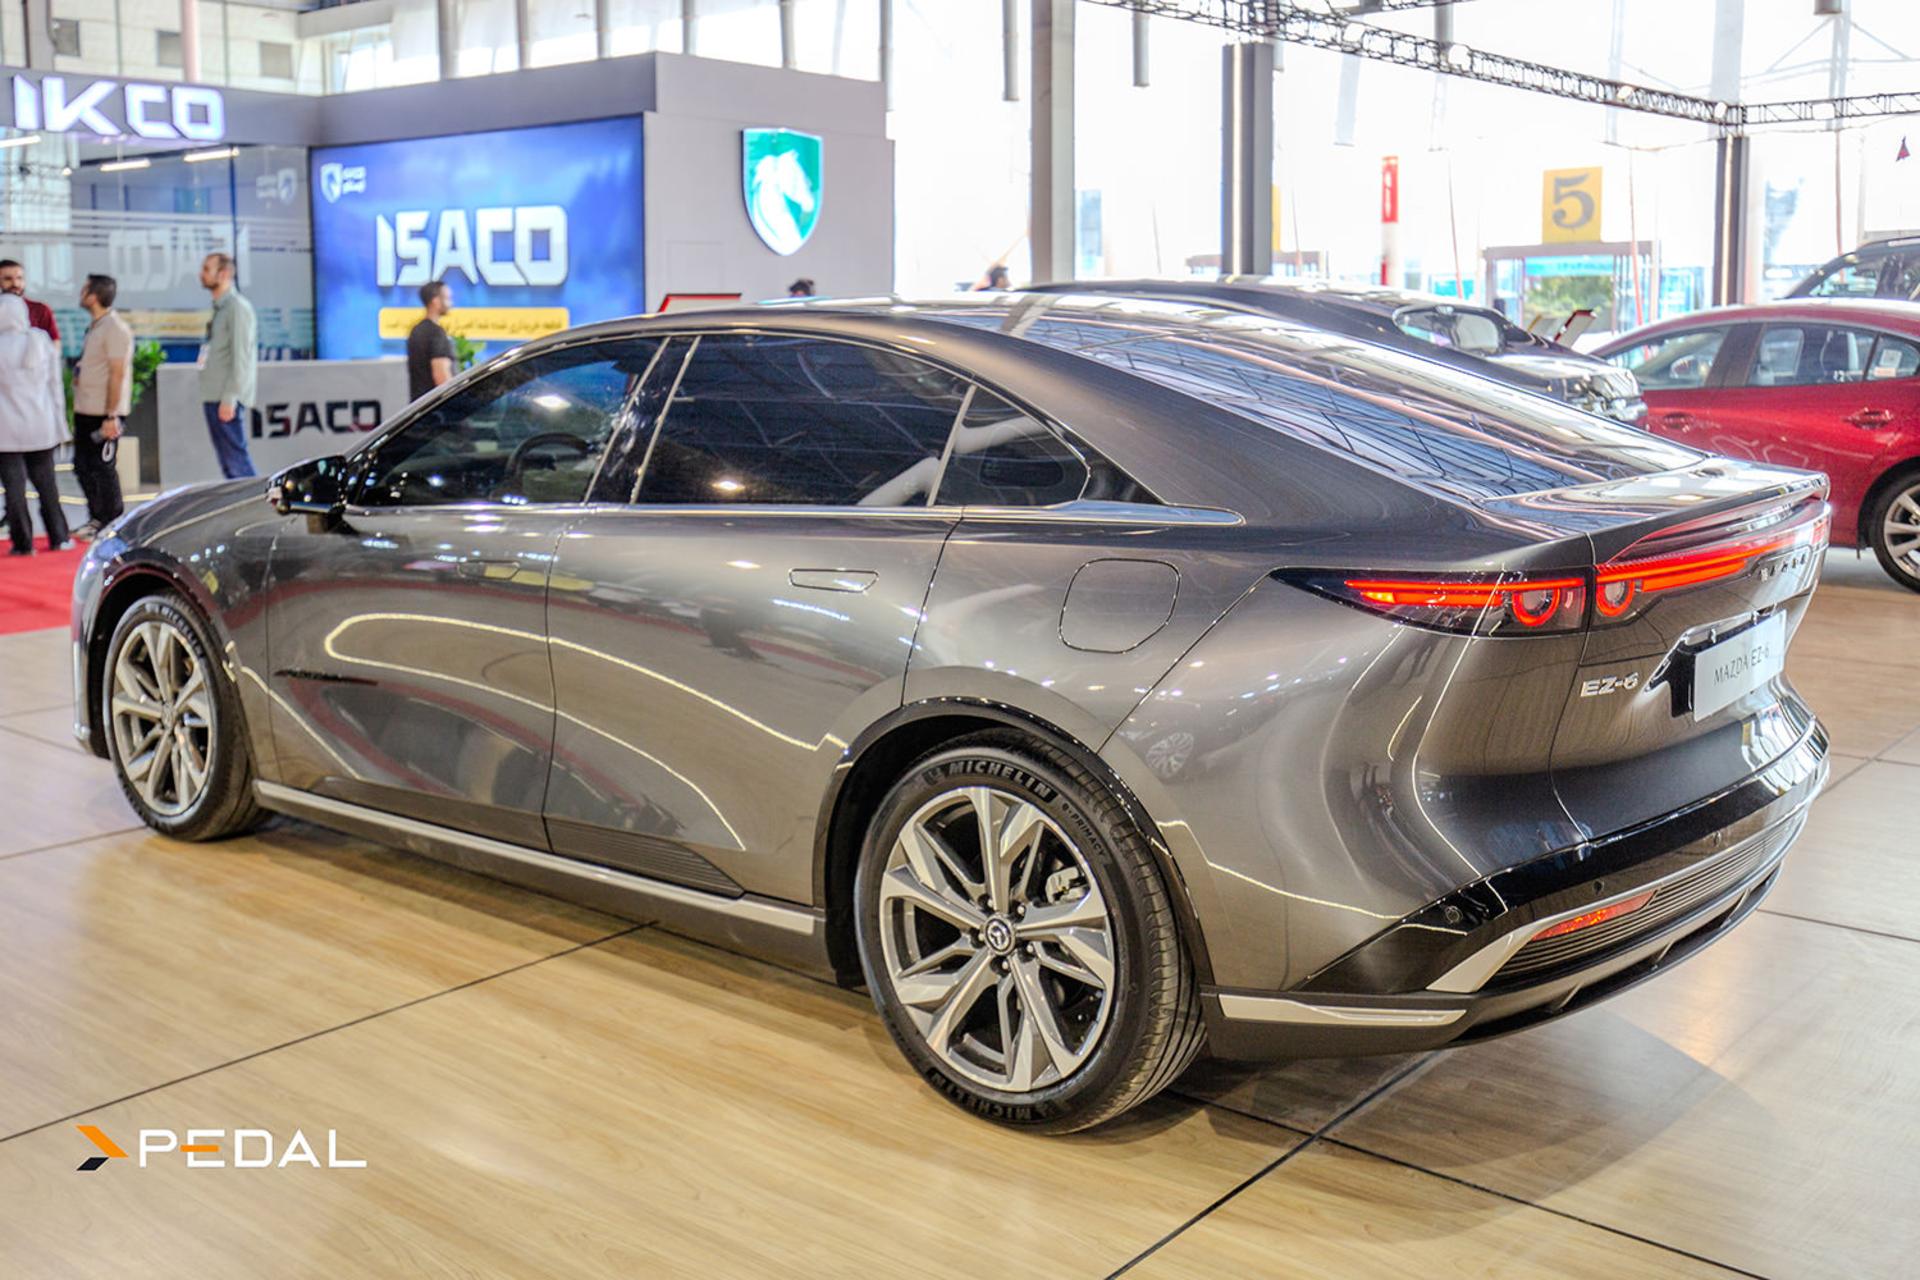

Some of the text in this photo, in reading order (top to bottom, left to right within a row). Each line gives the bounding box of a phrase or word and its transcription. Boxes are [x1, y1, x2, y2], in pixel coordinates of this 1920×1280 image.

[13, 74, 225, 140] IKCO
[1552, 173, 1595, 229] 5
[376, 206, 568, 286] ISACO
[251, 400, 381, 438] ISACO
[1581, 672, 1638, 696] EZ-6
[1713, 655, 1749, 686] MAZDA
[949, 760, 1051, 800] MICHELIN
